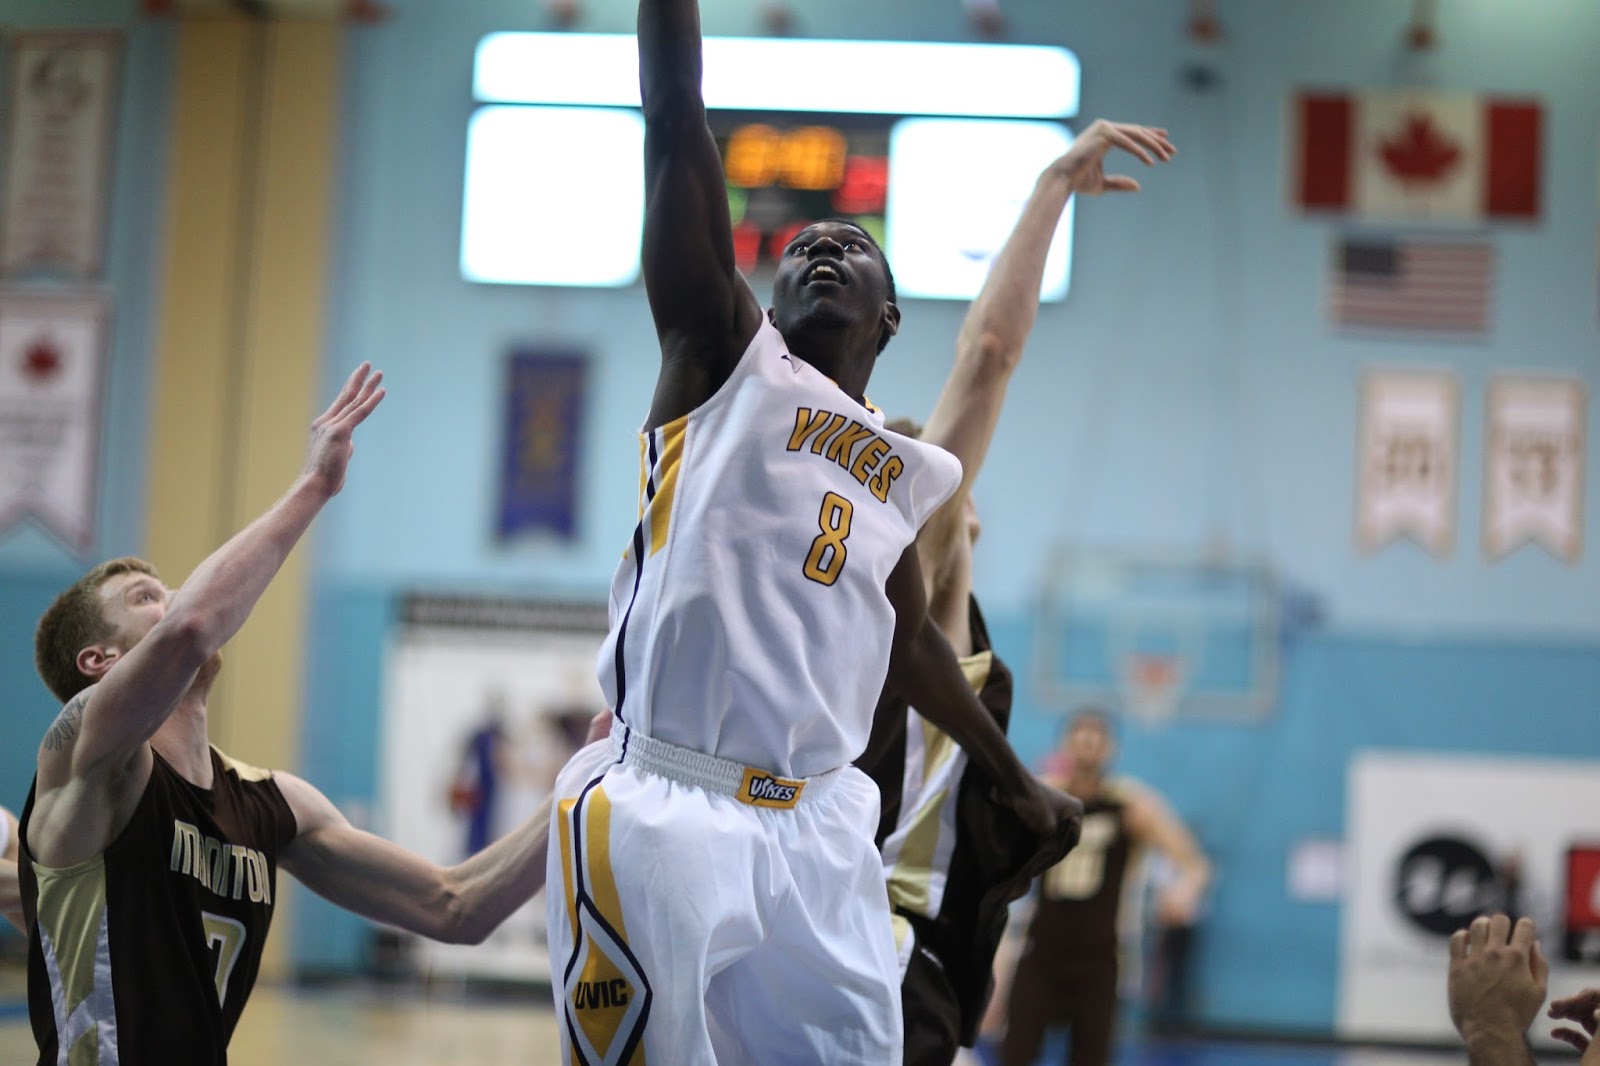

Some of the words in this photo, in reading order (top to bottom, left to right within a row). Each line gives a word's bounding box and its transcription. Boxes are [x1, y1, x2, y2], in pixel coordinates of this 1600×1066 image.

[786, 407, 904, 503] VIKES
[803, 491, 853, 586] 8
[749, 776, 798, 801] VIKES
[201, 910, 247, 1009] 7
[575, 978, 627, 1009] UVIC
